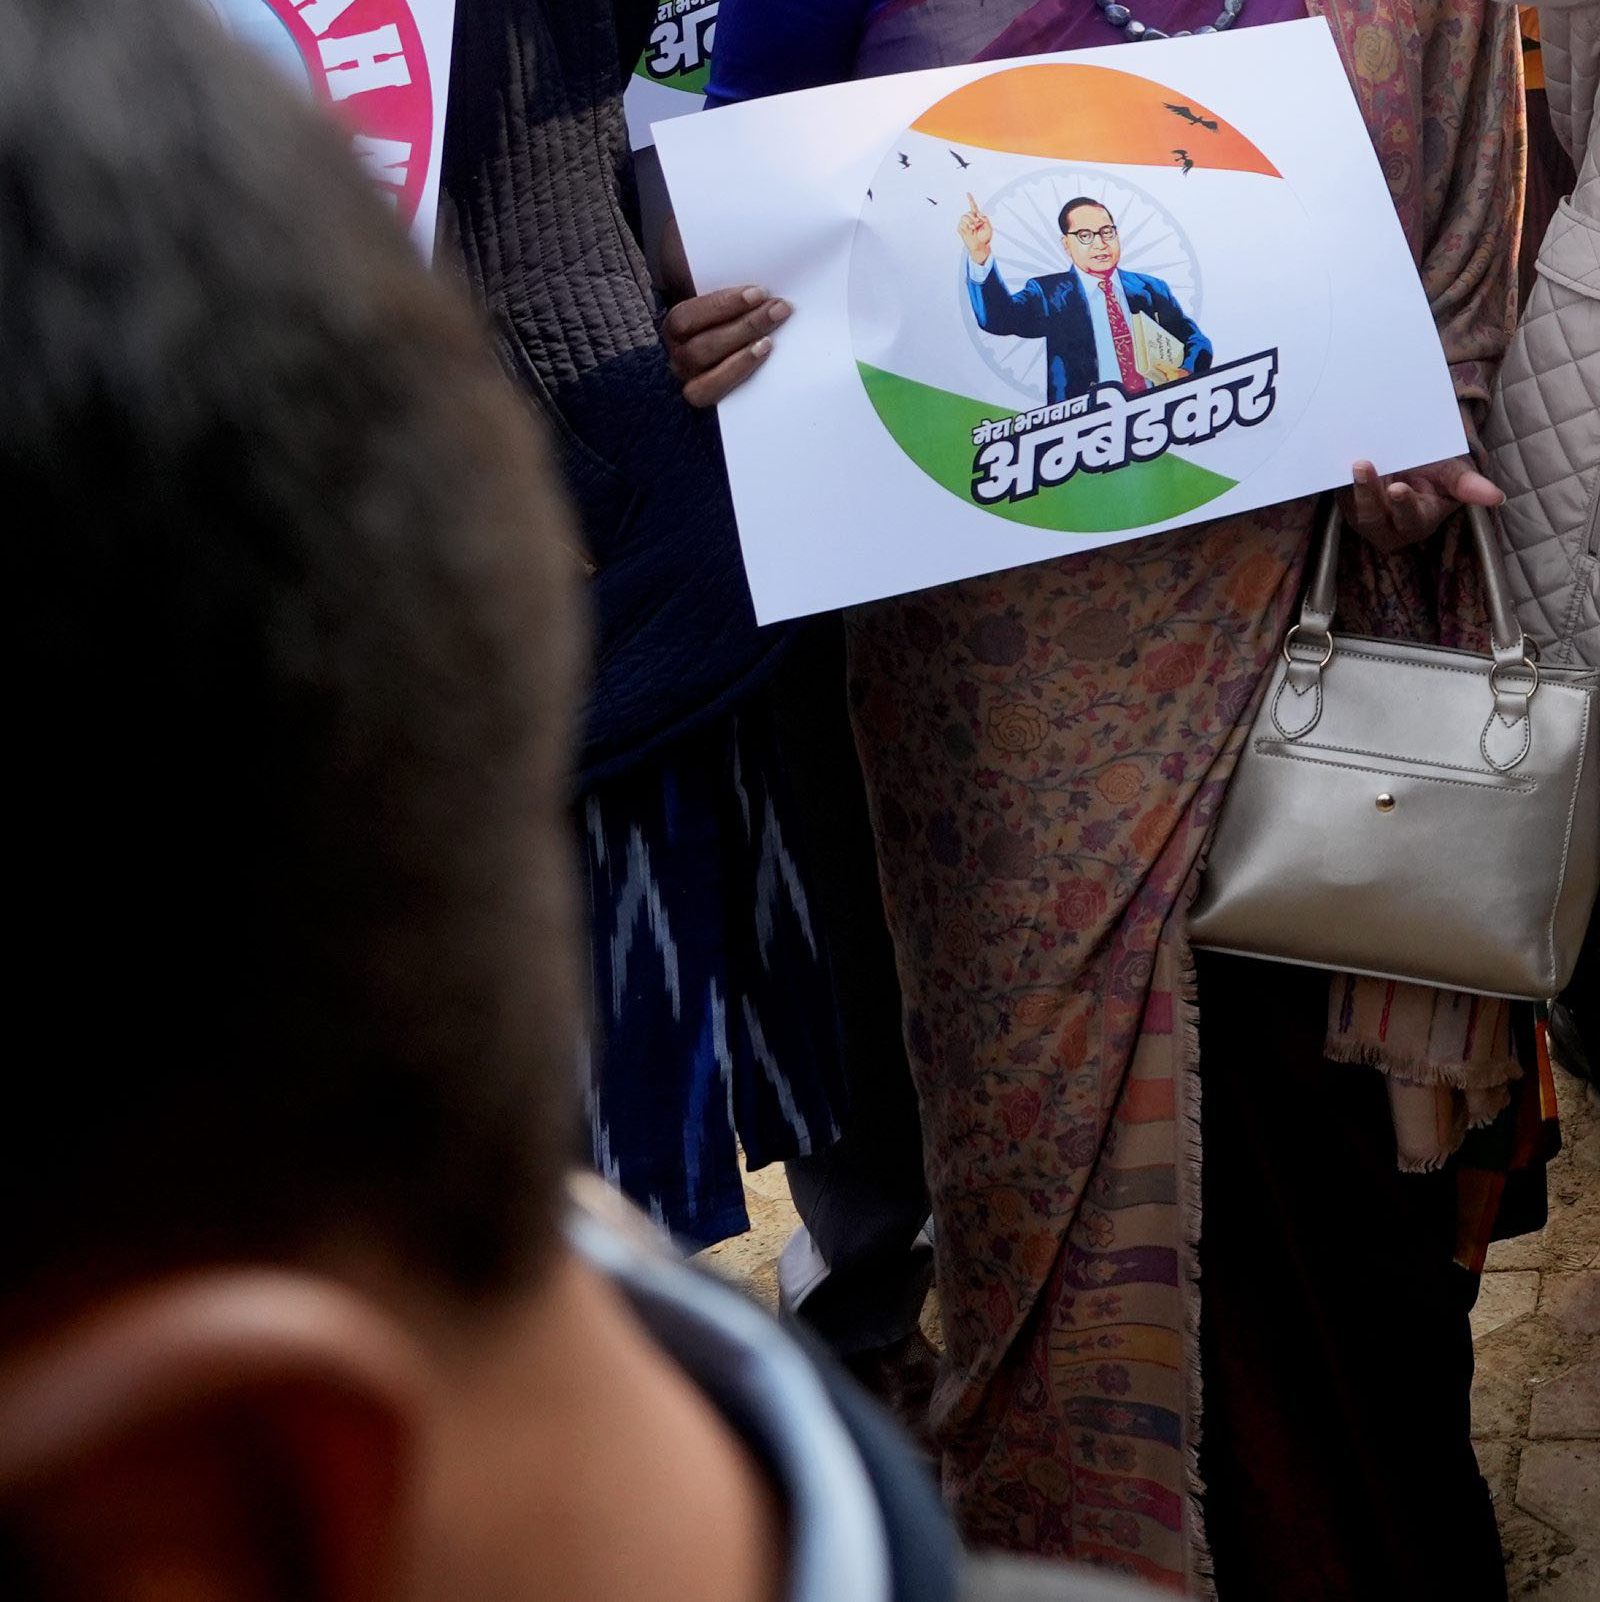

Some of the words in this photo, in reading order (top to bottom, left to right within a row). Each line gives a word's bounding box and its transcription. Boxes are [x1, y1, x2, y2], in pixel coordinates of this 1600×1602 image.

[972, 419, 1012, 445] मेरा
[1012, 393, 1090, 431] भगवान
[974, 351, 1277, 501] अम्बेडकर
